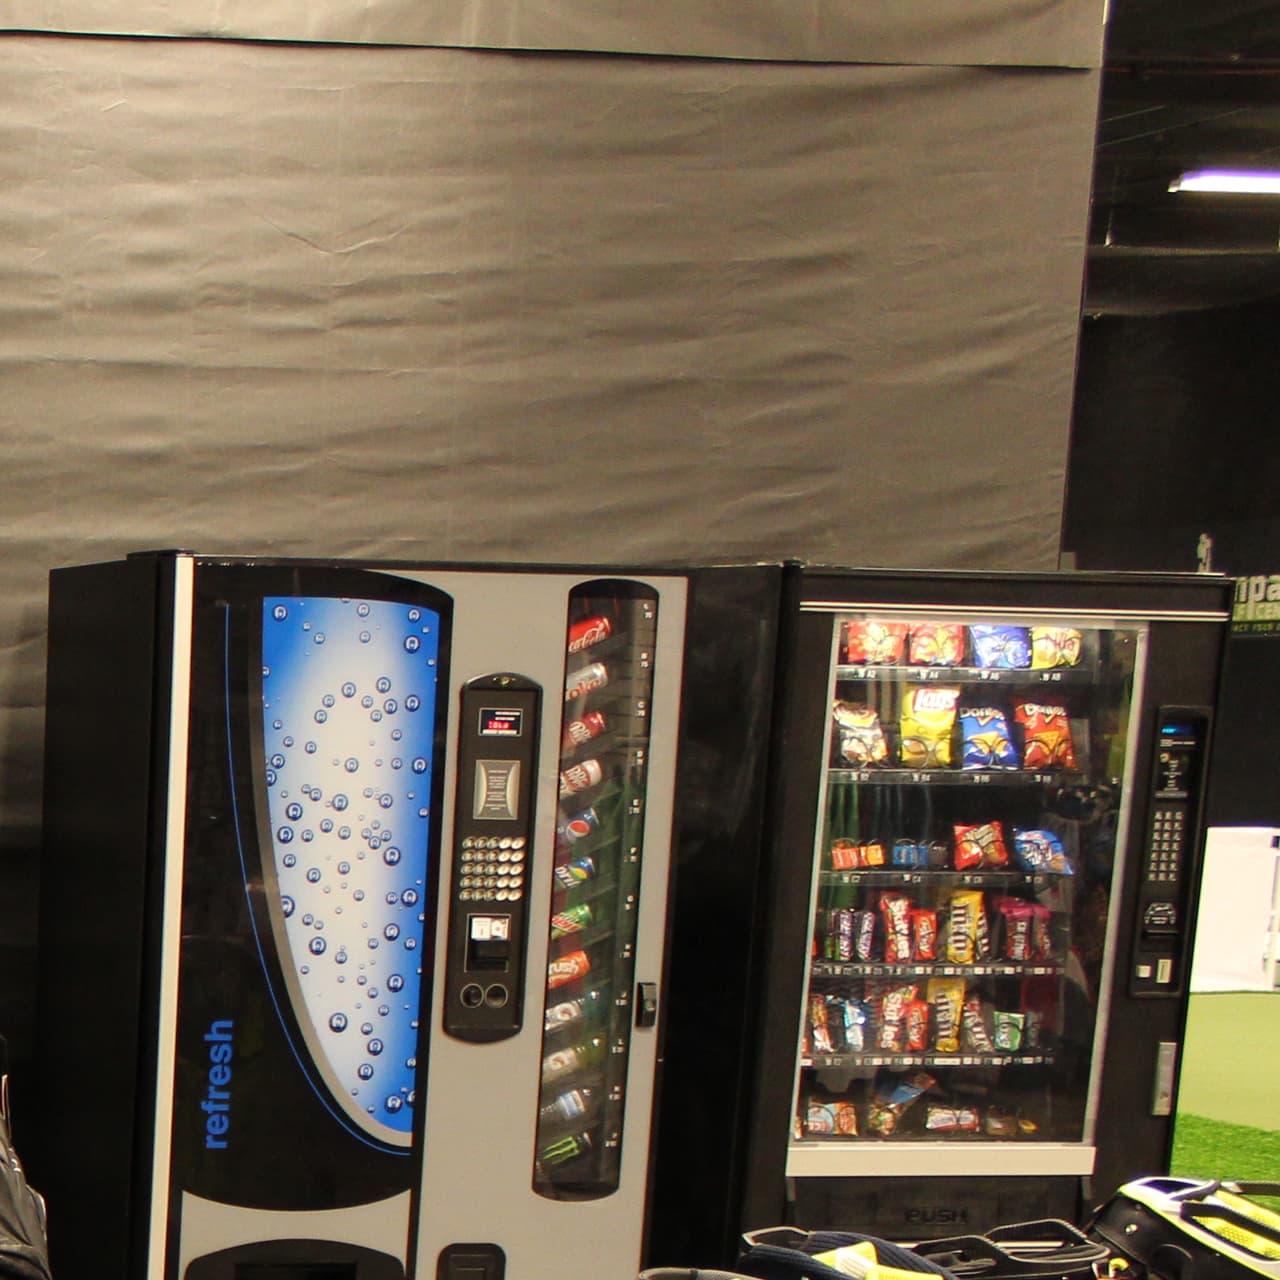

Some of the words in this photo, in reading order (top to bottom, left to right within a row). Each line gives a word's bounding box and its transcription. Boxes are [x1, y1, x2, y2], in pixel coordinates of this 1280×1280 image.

[549, 960, 579, 976] rush
[201, 1020, 233, 1148] refresh
[905, 1207, 968, 1224] PUSH
